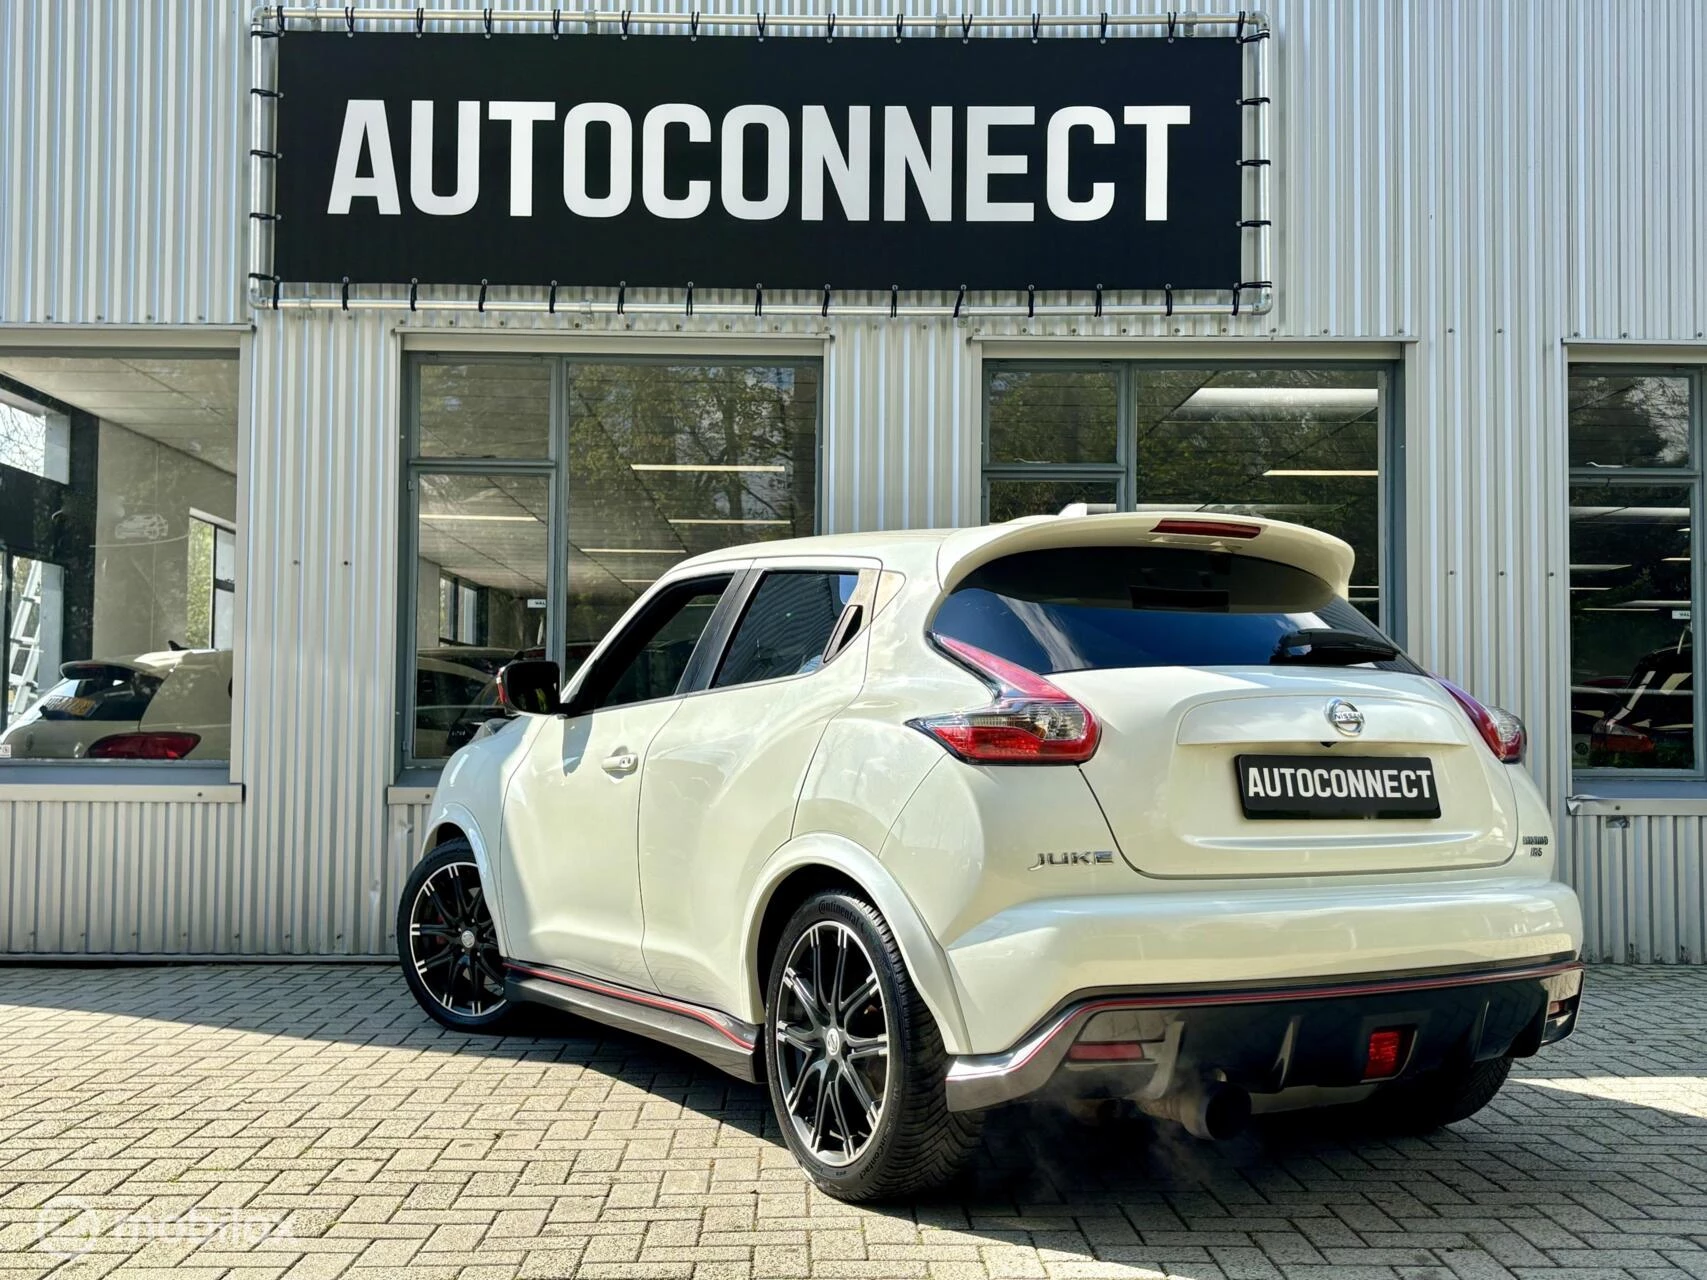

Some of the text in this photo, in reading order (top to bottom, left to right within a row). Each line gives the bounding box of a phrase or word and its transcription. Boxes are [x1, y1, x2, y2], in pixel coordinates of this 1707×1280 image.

[327, 100, 1191, 222] AUTOCONNECT
[1334, 712, 1363, 721] NISSAN
[1248, 767, 1432, 799] AUTOCONNECT
[1028, 851, 1113, 871] JUKE
[818, 900, 860, 928] Continental
